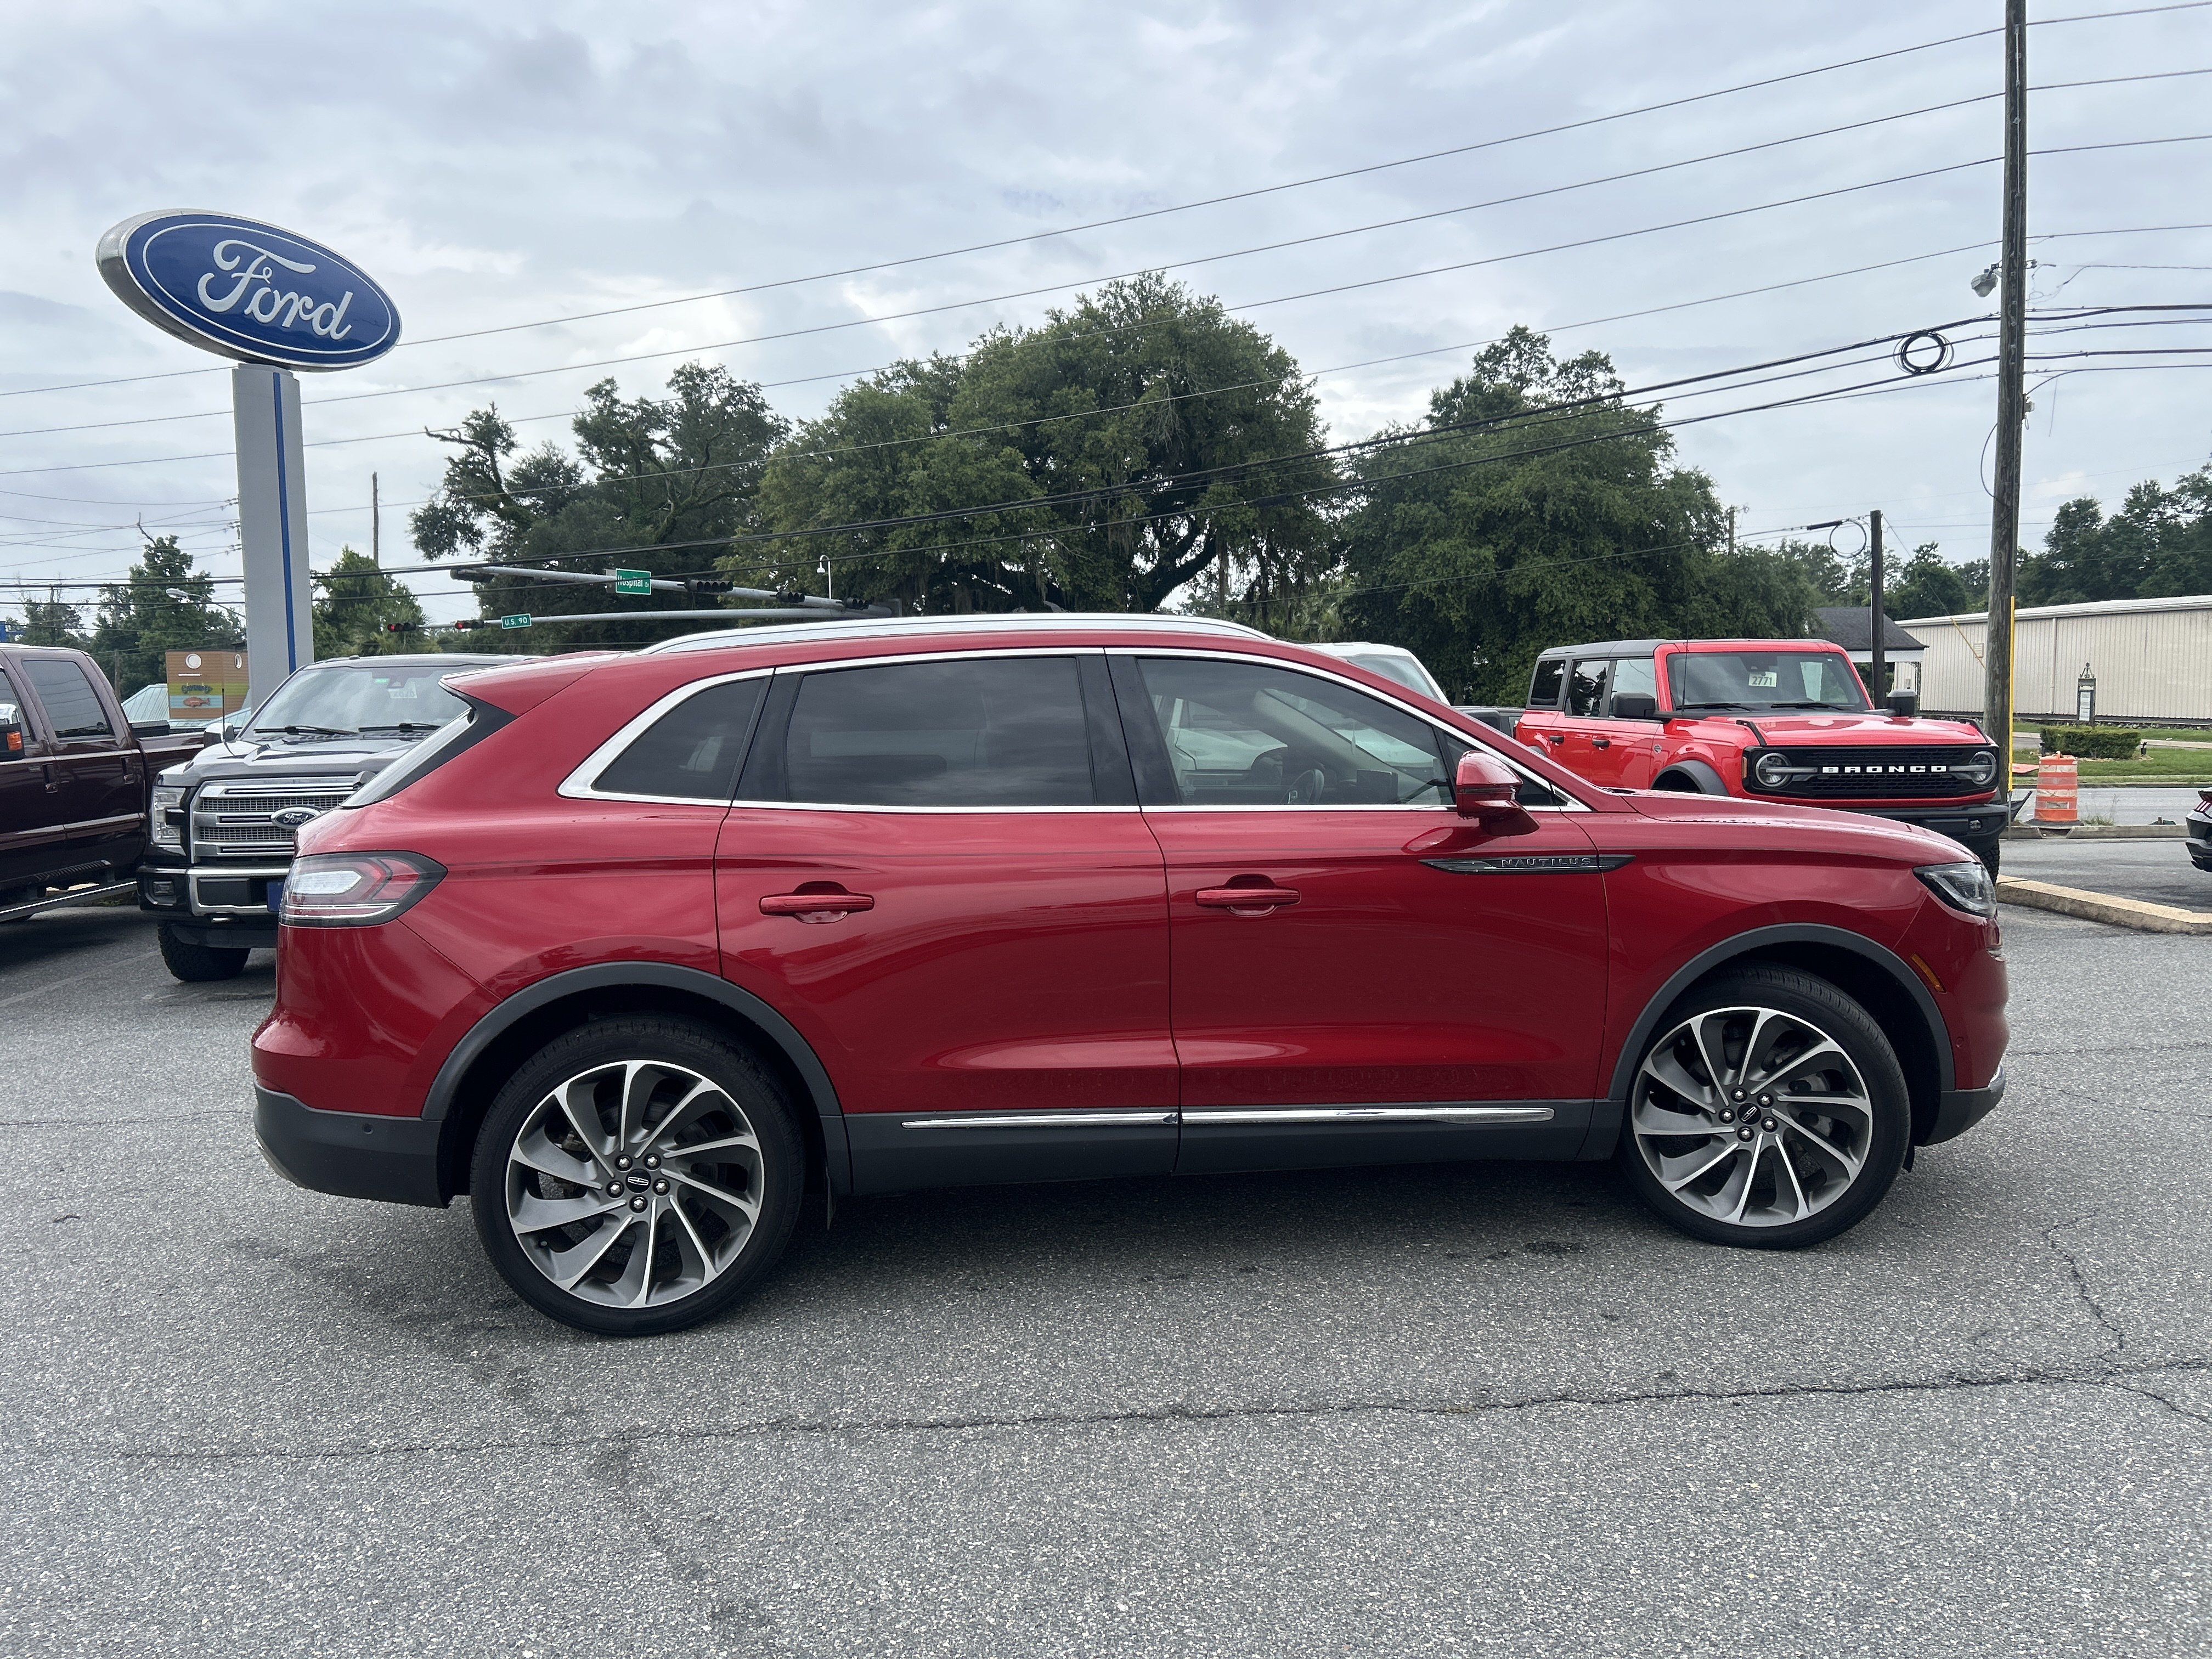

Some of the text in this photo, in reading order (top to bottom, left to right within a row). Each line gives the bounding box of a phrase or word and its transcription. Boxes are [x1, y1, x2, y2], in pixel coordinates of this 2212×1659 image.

[198, 240, 353, 341] Ford
[617, 575, 643, 588] Hospital
[1752, 676, 1773, 686] 2771
[283, 813, 308, 823] Ford
[1502, 857, 1591, 867] NAUTILUS
